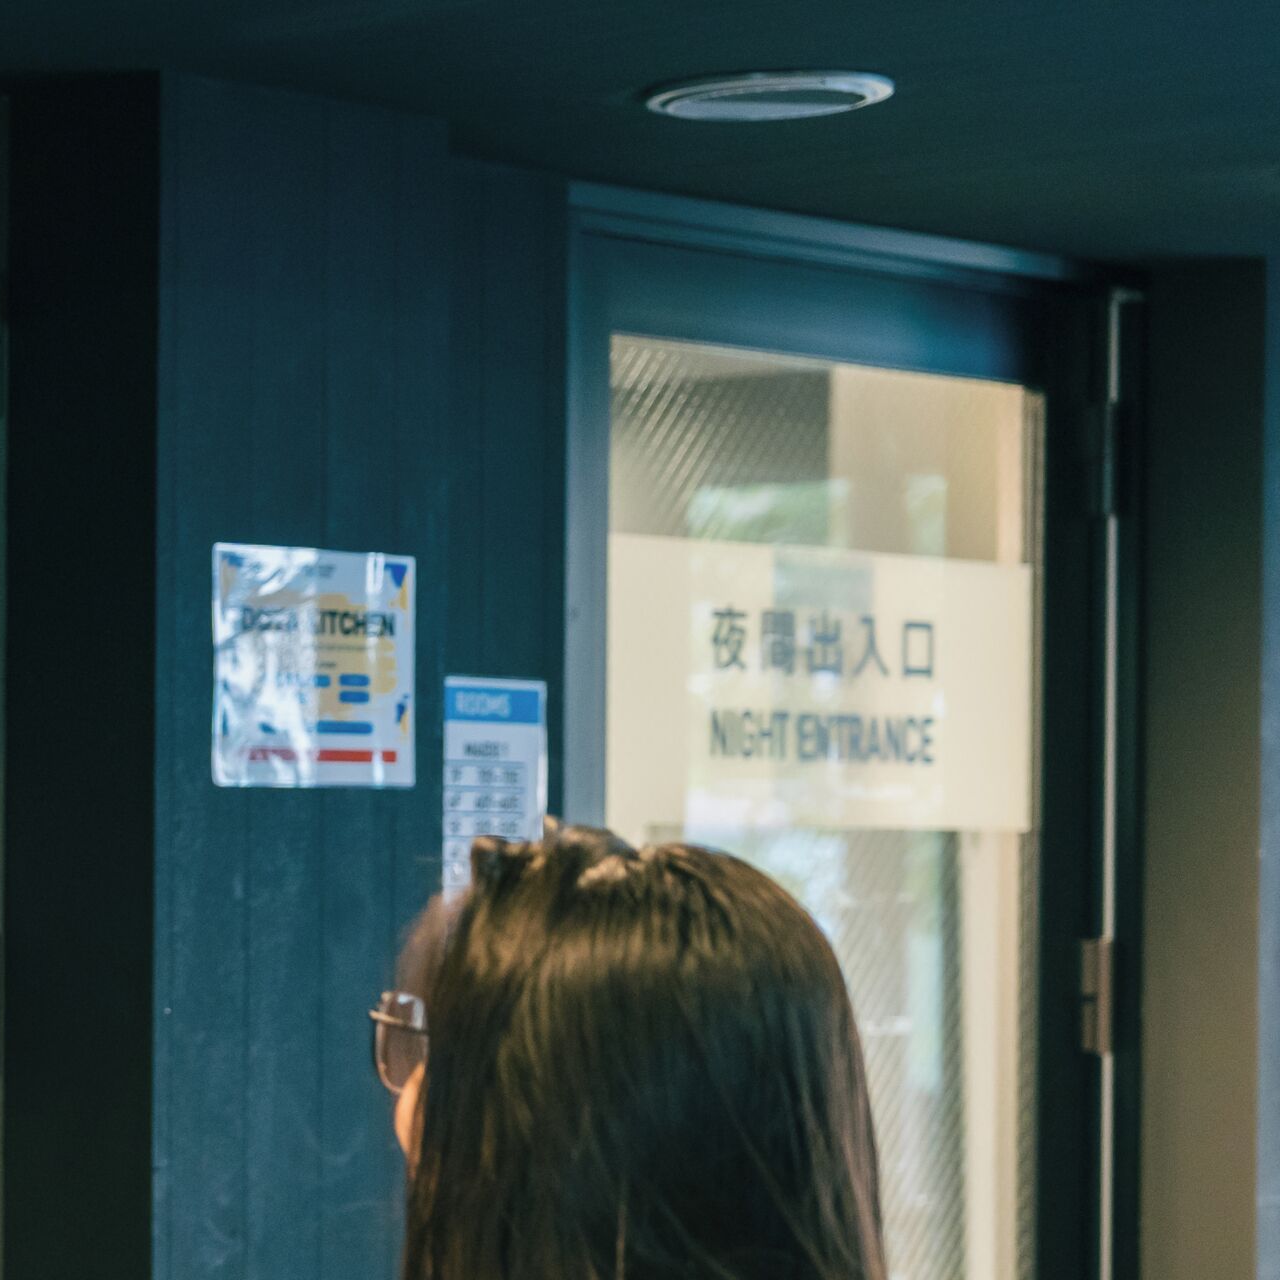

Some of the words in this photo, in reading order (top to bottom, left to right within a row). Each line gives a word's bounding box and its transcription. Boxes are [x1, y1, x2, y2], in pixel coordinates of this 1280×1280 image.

[711, 606, 934, 678] 夜間出入口
[710, 710, 789, 758] NIGHT
[797, 712, 934, 764] ENTRANCE
